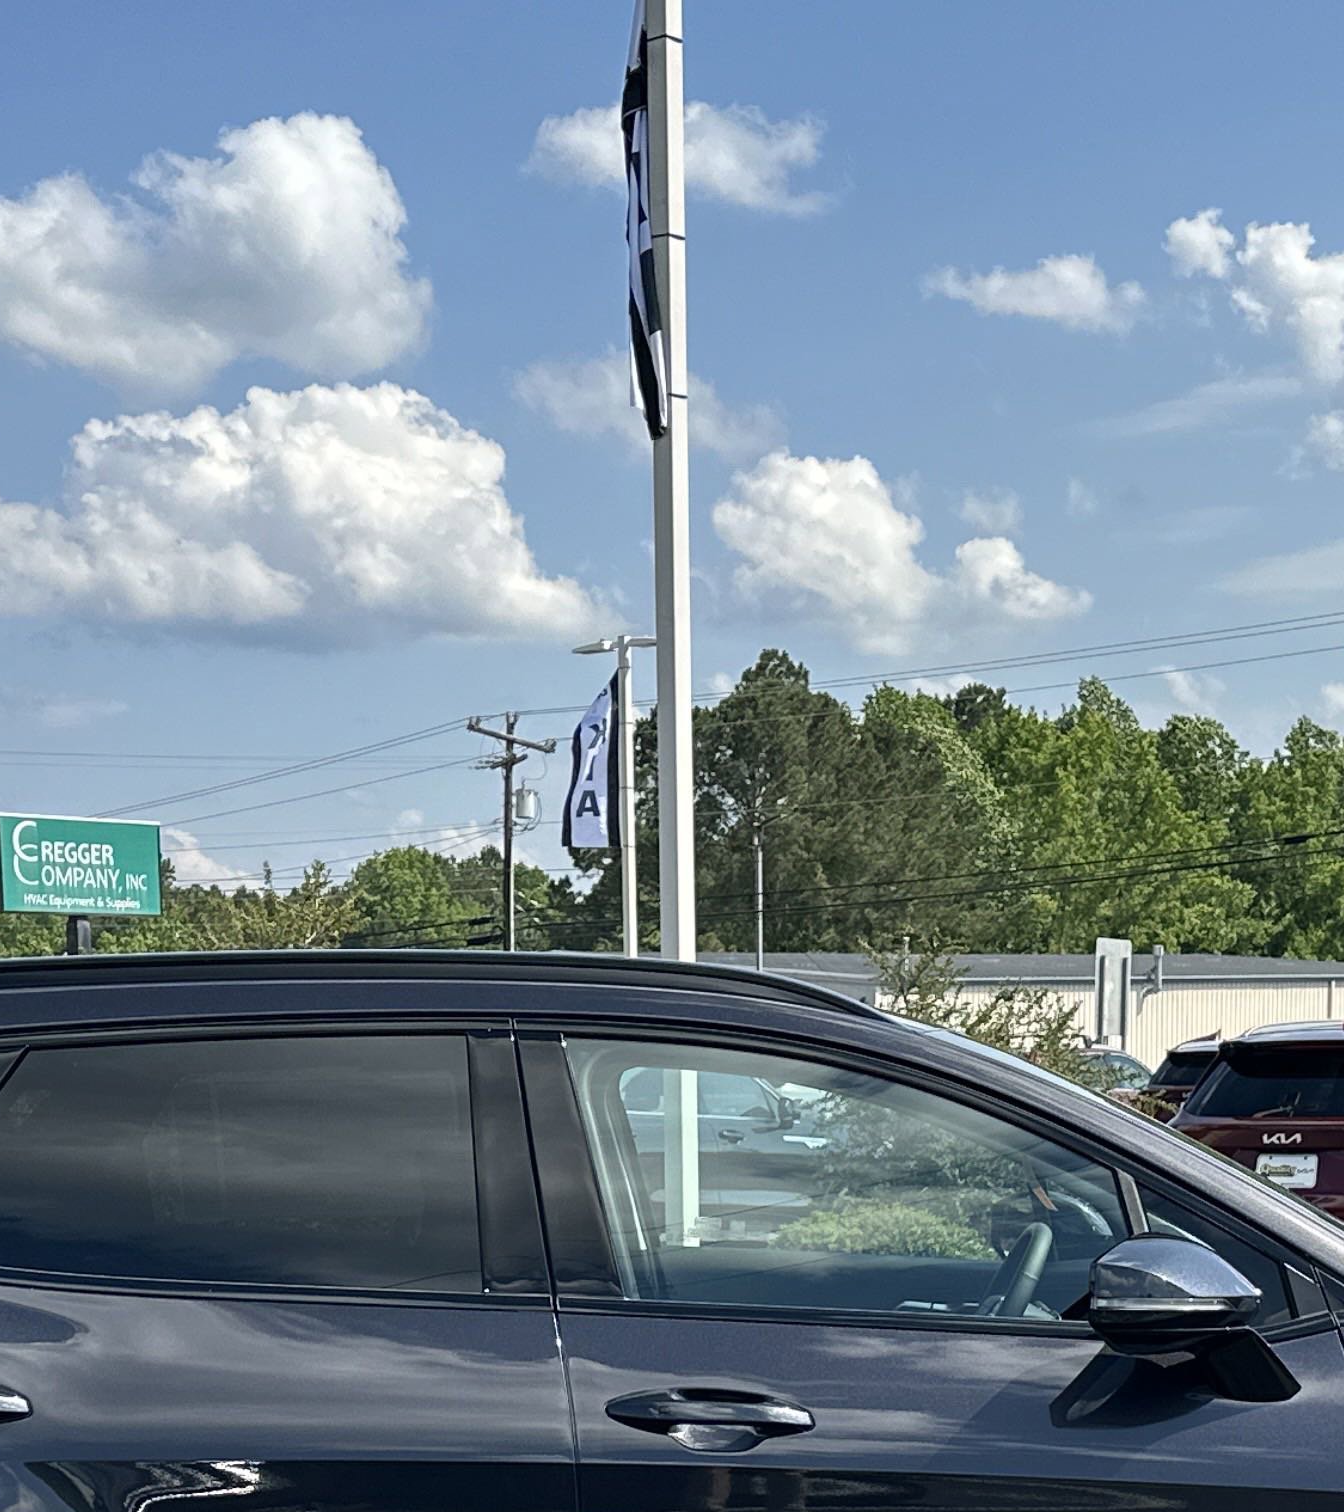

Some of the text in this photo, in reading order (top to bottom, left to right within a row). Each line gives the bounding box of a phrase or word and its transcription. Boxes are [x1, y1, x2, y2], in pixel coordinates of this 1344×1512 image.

[12, 820, 114, 866] CREGGER
[13, 844, 147, 893] COMPANY, INC
[23, 893, 141, 910] HVAC Equipment & Supplies
[1262, 1132, 1302, 1144] KIA
